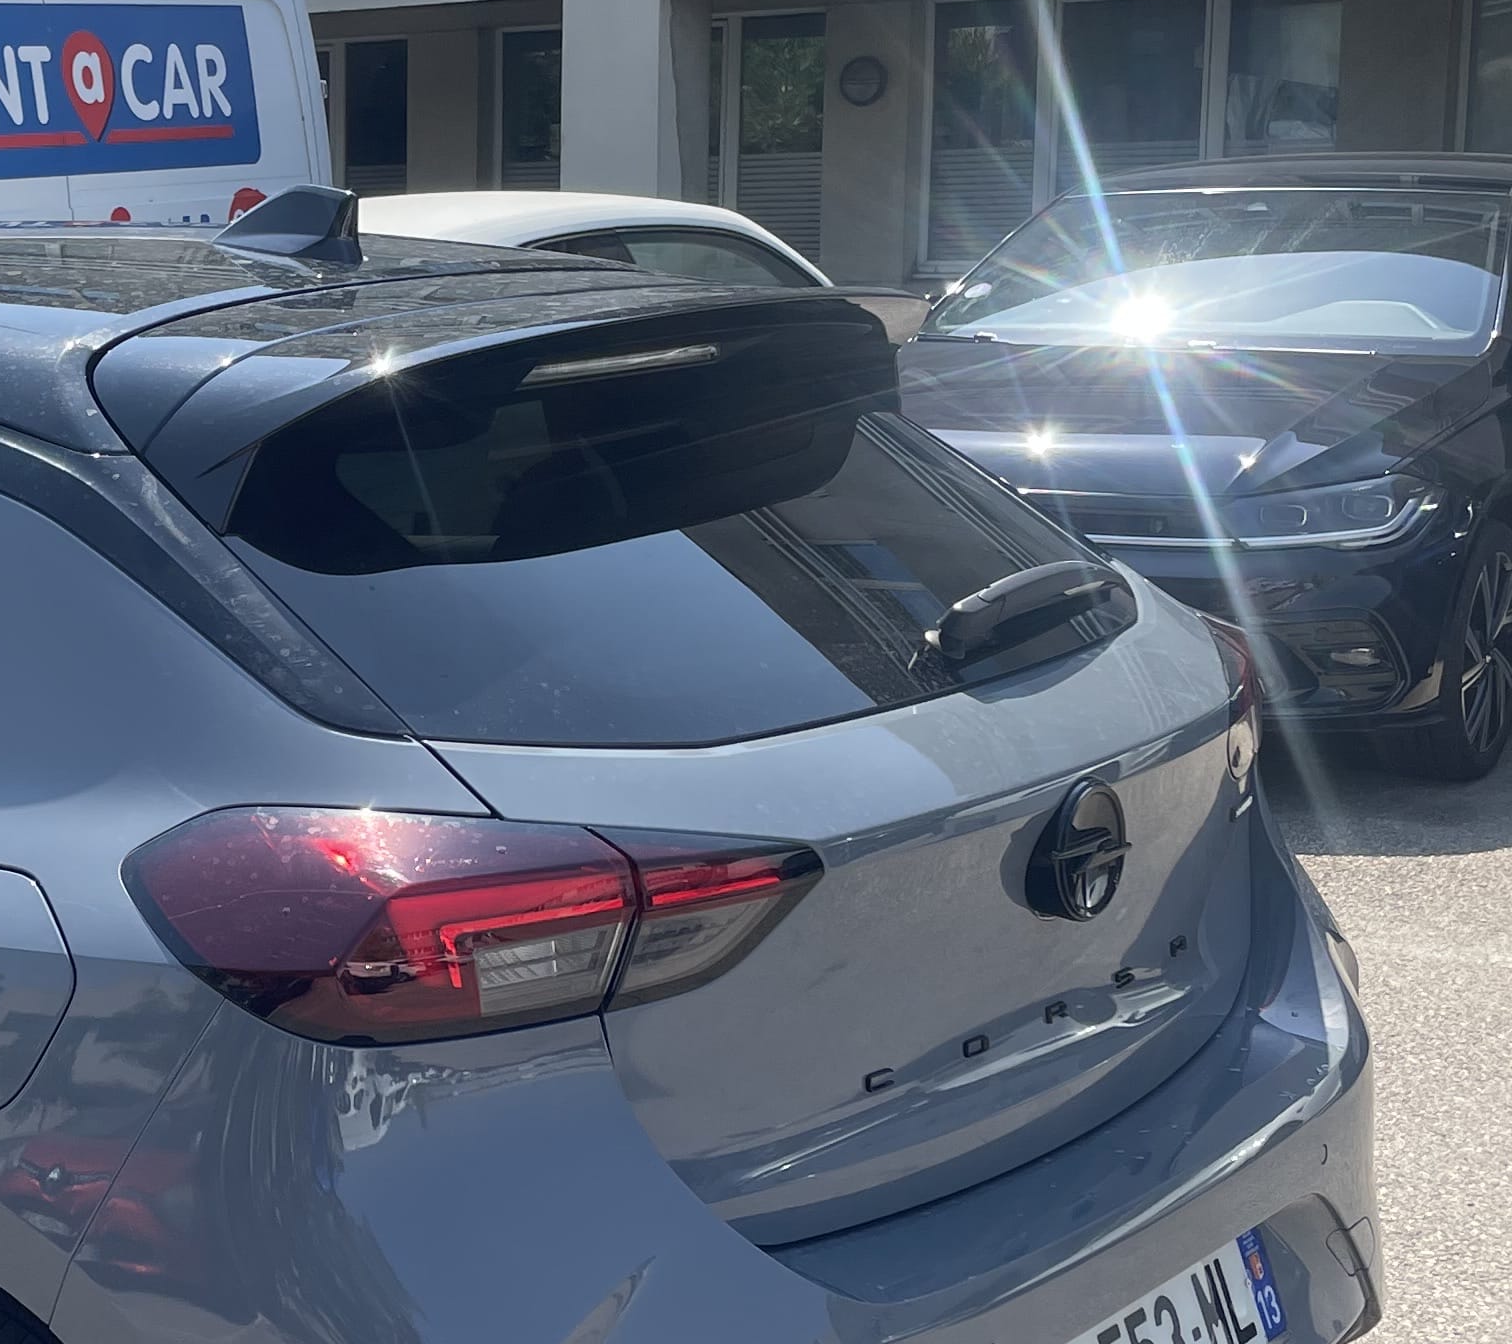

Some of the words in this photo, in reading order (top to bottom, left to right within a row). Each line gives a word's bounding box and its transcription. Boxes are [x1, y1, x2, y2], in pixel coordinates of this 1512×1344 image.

[120, 43, 232, 120] CAR
[864, 935, 1187, 1093] CORSA
[1257, 1285, 1281, 1329] 13
